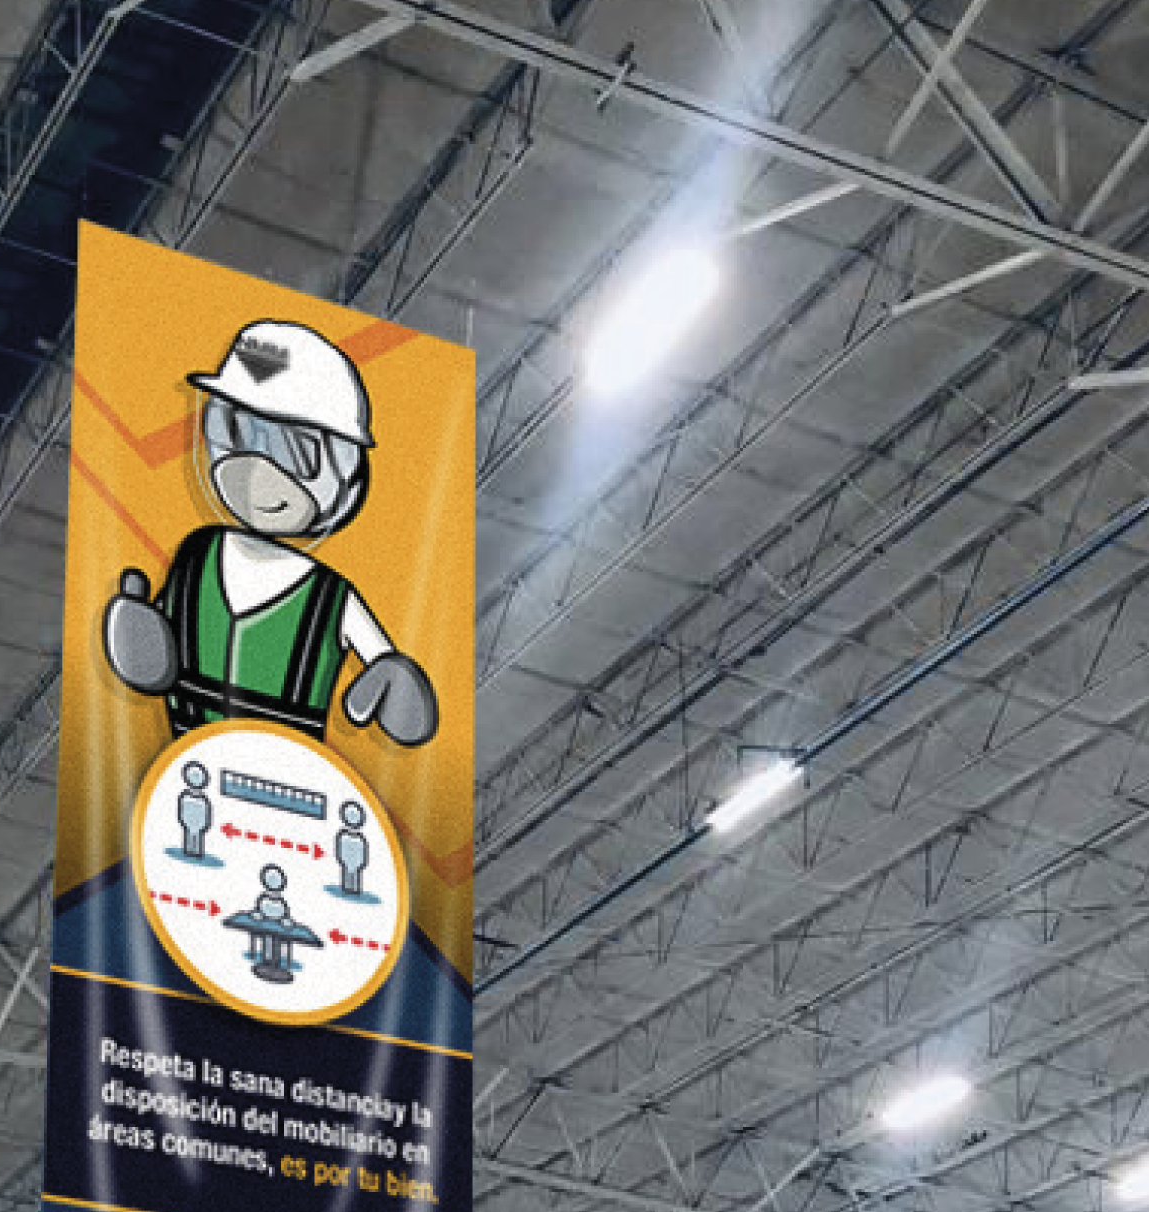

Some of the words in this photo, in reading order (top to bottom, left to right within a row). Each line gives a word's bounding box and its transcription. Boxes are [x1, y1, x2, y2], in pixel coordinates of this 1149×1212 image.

[100, 1037, 196, 1081] Respeta
[202, 1058, 224, 1087] la
[229, 1069, 285, 1099] sana
[411, 1101, 433, 1128] la
[101, 1077, 236, 1127] disposición
[241, 1105, 278, 1137] del
[283, 1117, 397, 1159] mobiliario
[402, 1142, 431, 1165] en
[88, 1113, 155, 1151] áreas
[161, 1132, 275, 1177] comunes,
[280, 1154, 307, 1181] es
[313, 1160, 351, 1187] por
[357, 1166, 380, 1193] tu
[385, 1169, 440, 1206] bien.
